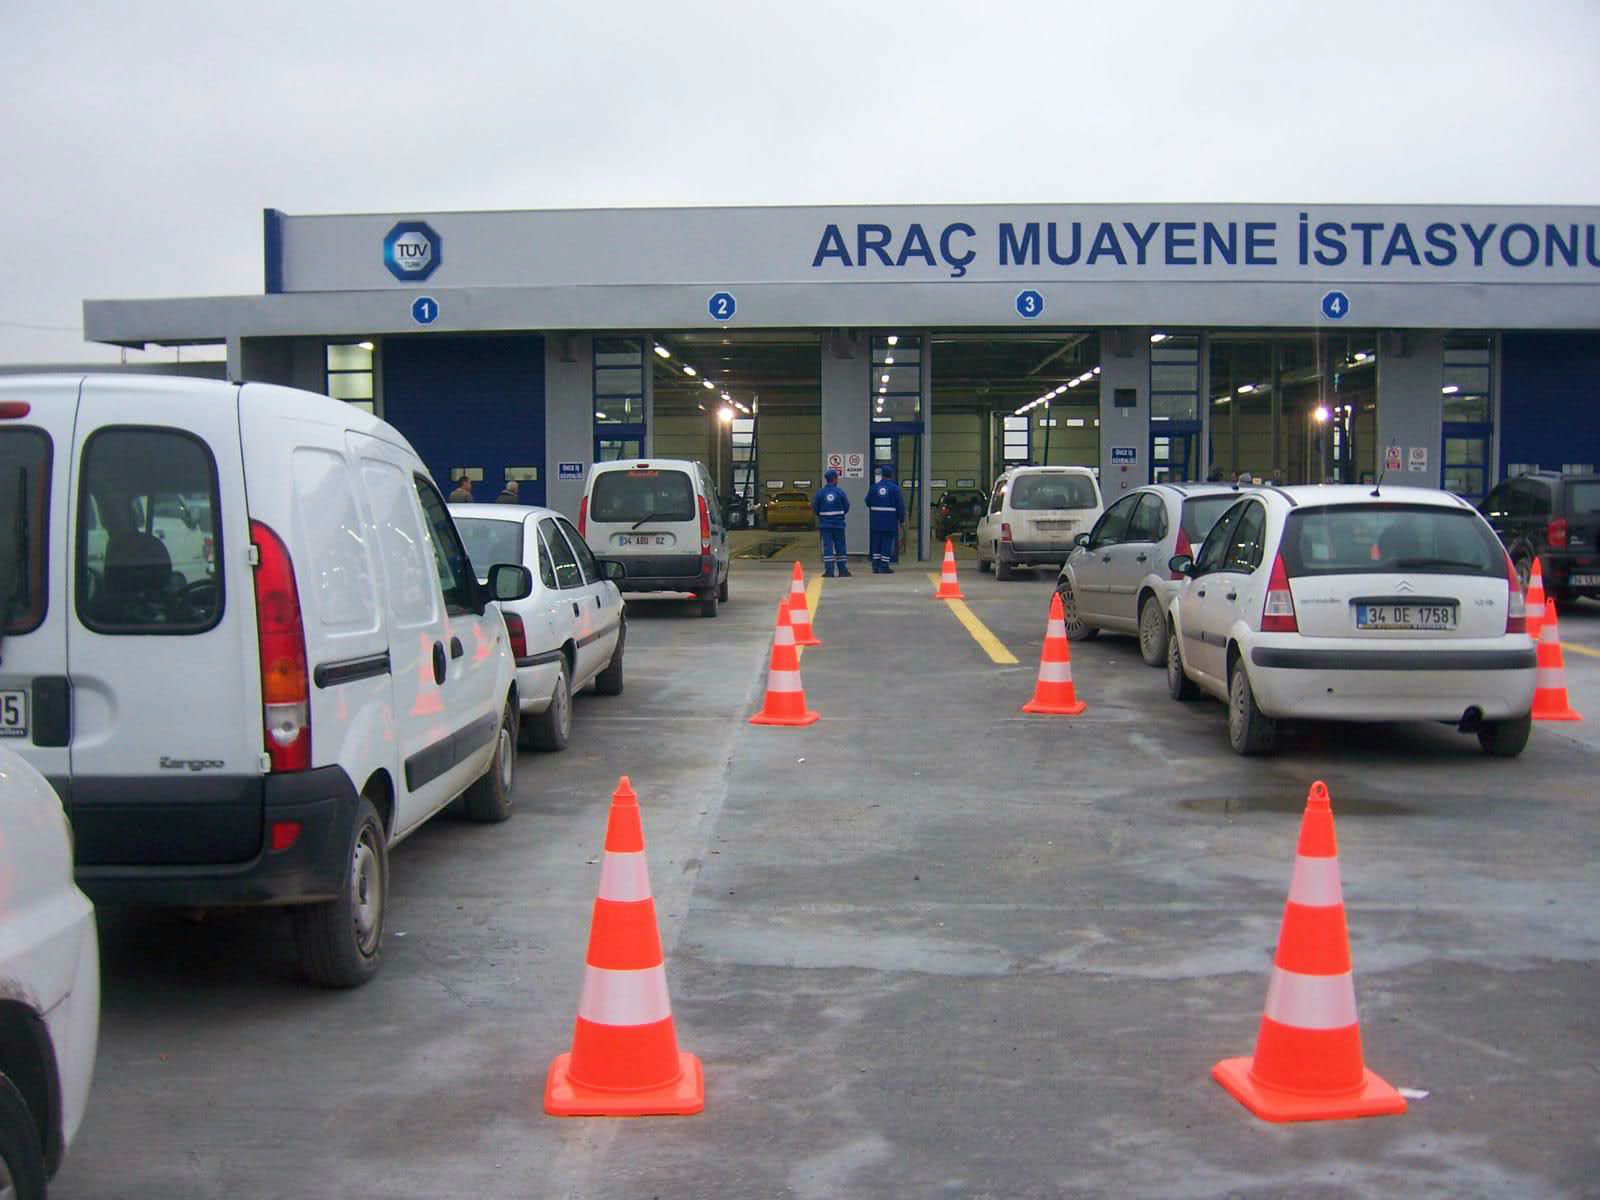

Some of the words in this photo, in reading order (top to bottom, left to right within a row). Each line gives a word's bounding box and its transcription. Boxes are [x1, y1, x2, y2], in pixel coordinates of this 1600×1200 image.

[812, 223, 977, 278] ARAÇ
[999, 223, 1278, 267] MUAYENE
[420, 302, 429, 319] 1
[717, 298, 728, 315] 2
[1025, 296, 1035, 312] 3
[1330, 297, 1341, 314] 4
[1368, 607, 1386, 624] 34
[1393, 607, 1411, 624] DE
[1418, 607, 1449, 624] 1758
[0, 695, 19, 726] 5
